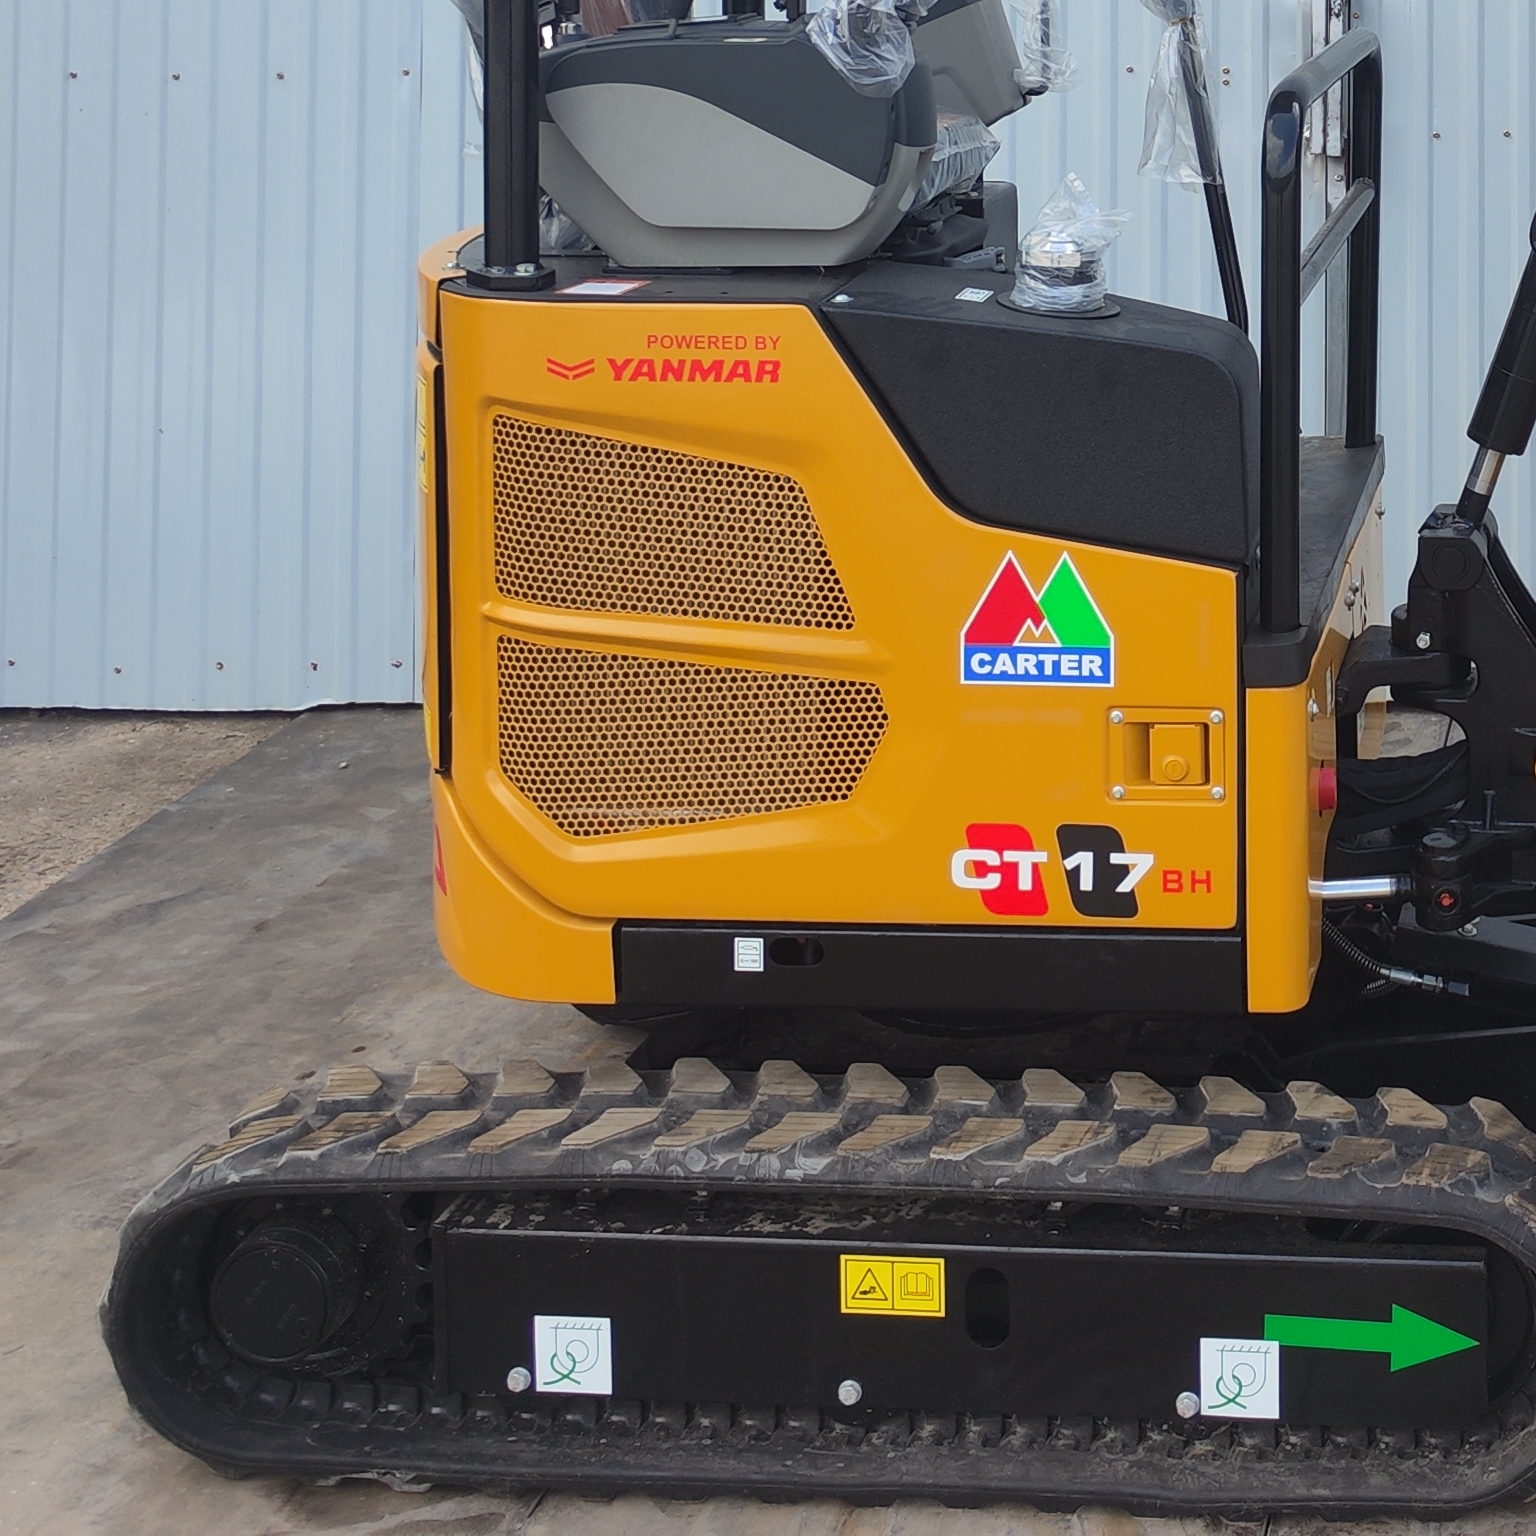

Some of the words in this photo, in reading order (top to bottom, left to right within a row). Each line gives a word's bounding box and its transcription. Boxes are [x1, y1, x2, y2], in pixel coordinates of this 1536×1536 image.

[647, 335, 747, 350] POWERED
[755, 336, 781, 350] BY
[607, 359, 781, 382] YANMAR
[970, 653, 1103, 676] CARTER
[1162, 870, 1212, 894] BH
